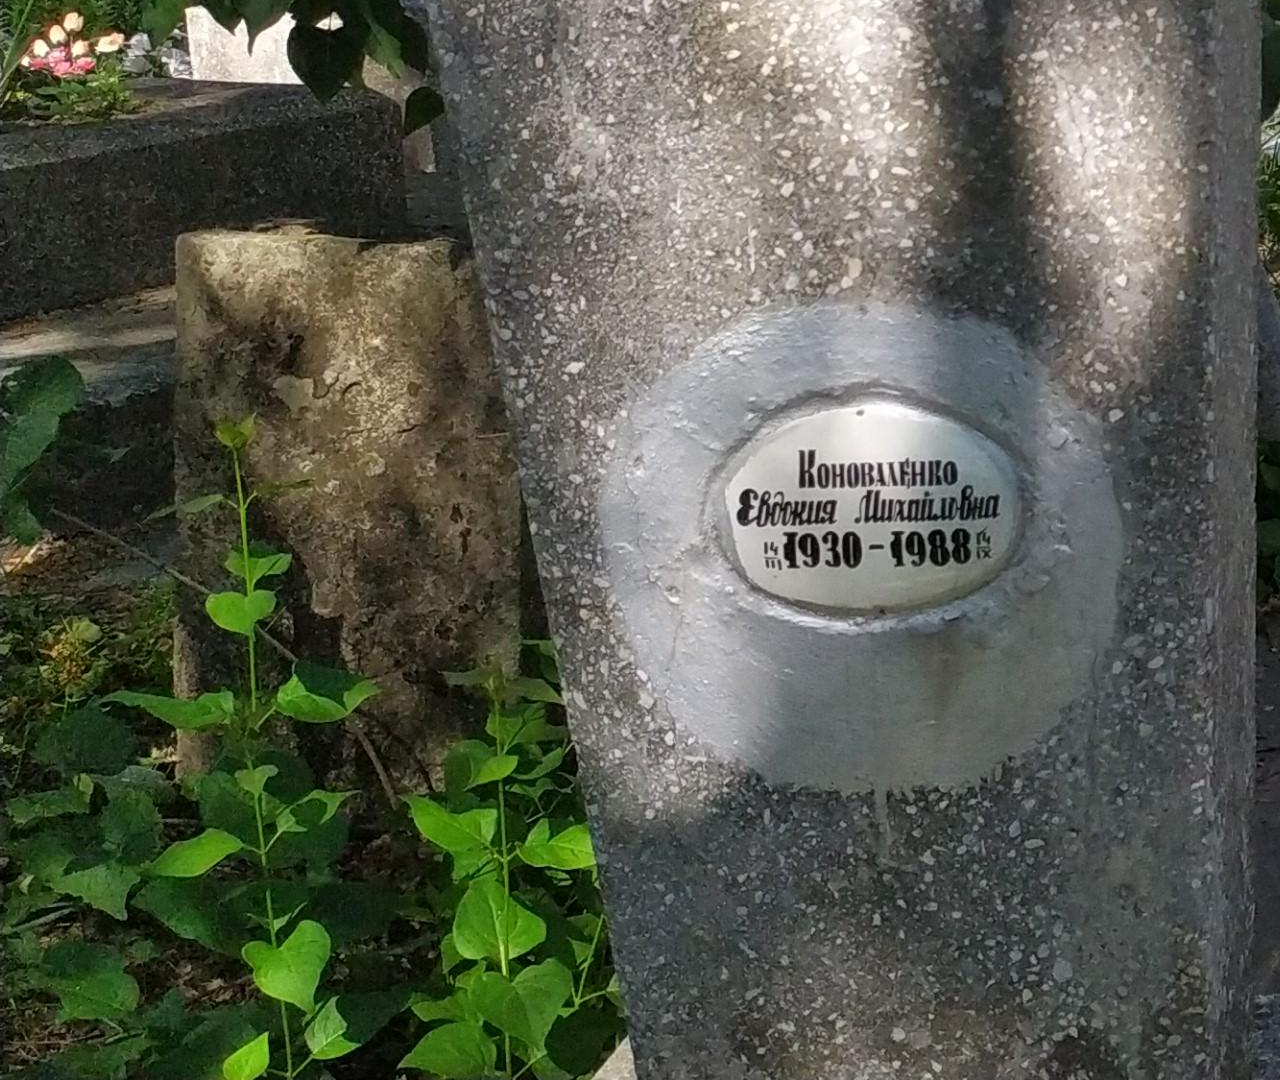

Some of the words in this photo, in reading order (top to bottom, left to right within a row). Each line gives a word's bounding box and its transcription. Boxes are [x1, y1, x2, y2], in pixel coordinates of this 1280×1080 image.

[798, 449, 959, 489] КОНОВАЛЕНКО
[736, 488, 837, 527] Евдокия
[854, 485, 1000, 523] Михайловна
